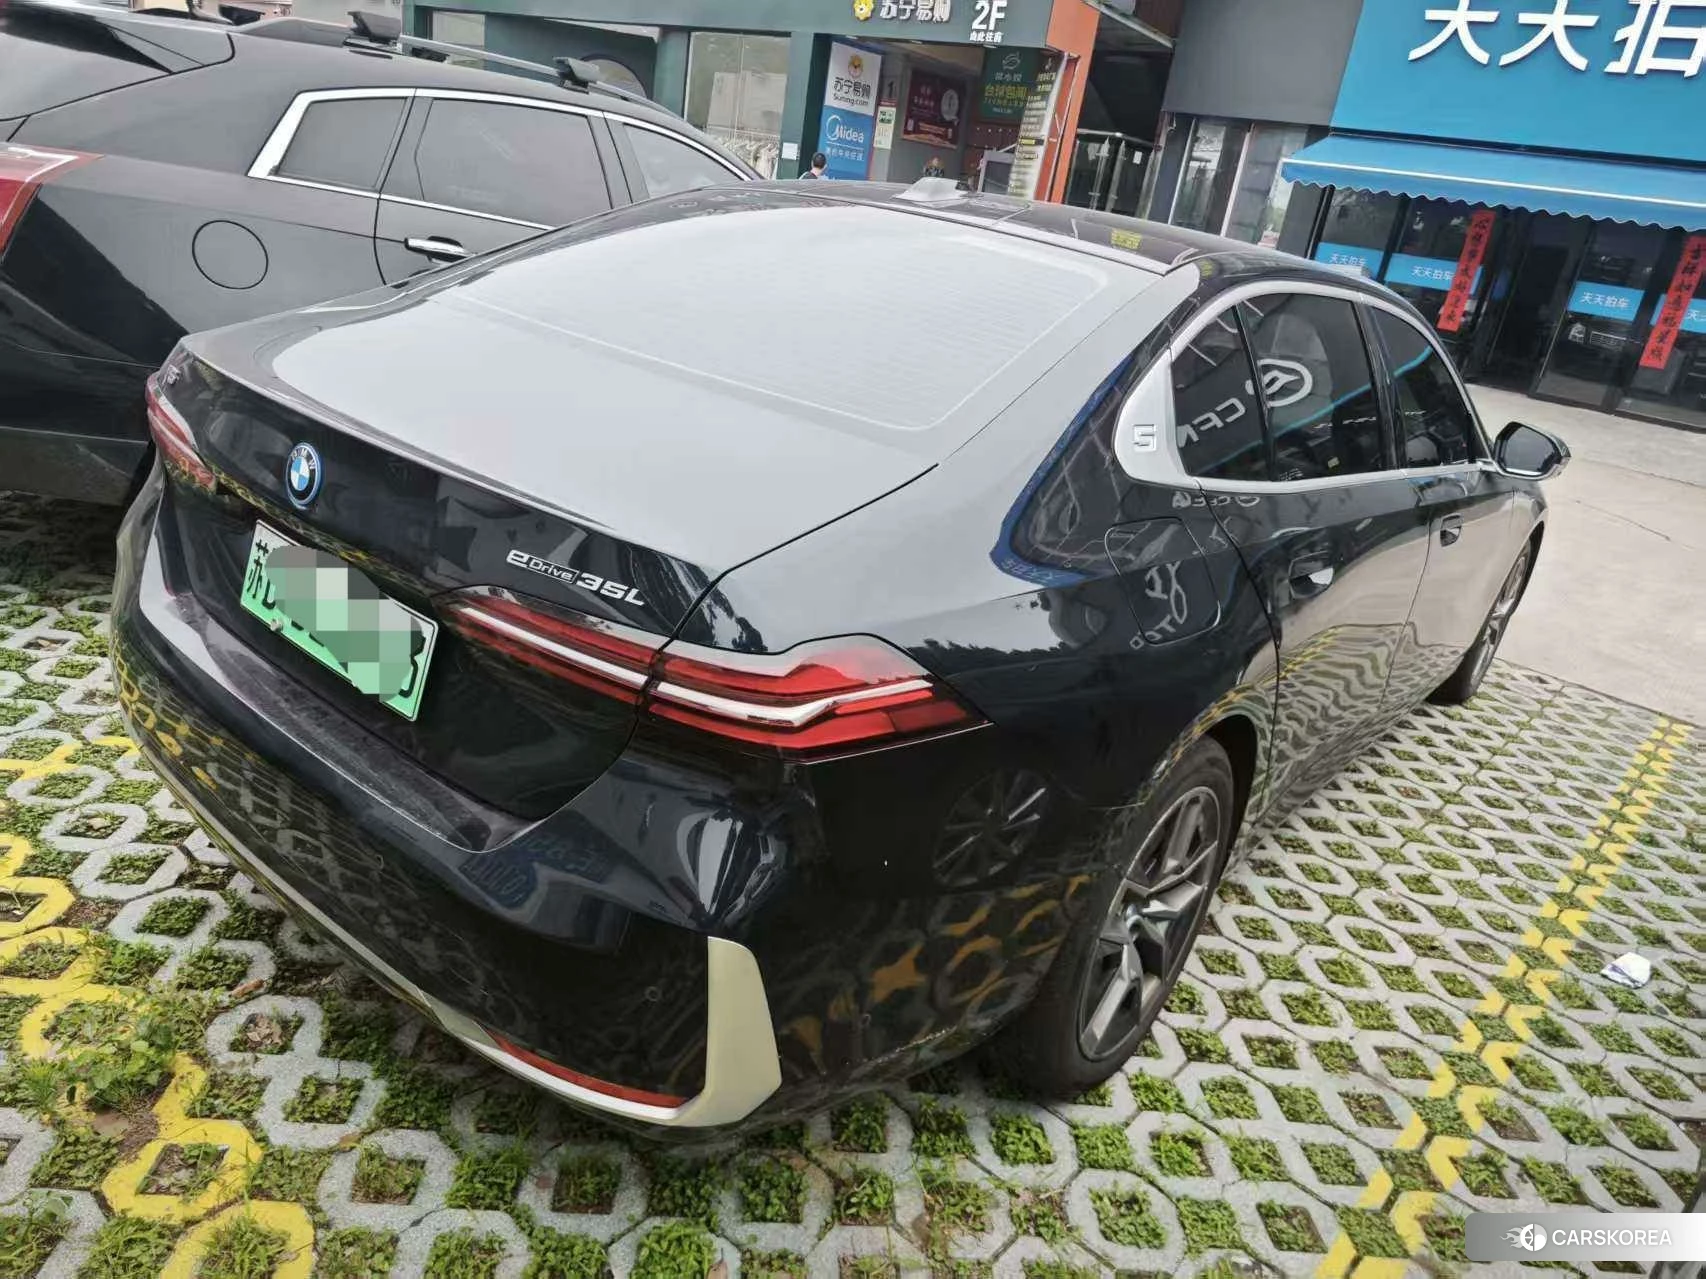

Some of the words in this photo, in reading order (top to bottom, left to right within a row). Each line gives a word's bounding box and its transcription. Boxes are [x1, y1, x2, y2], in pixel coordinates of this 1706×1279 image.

[879, 0, 951, 22] 苏宁易购
[971, 0, 1008, 31] 2F
[833, 76, 871, 99] 苏宁易购
[825, 115, 864, 143] Midea
[1580, 291, 1630, 309] 天天拍车
